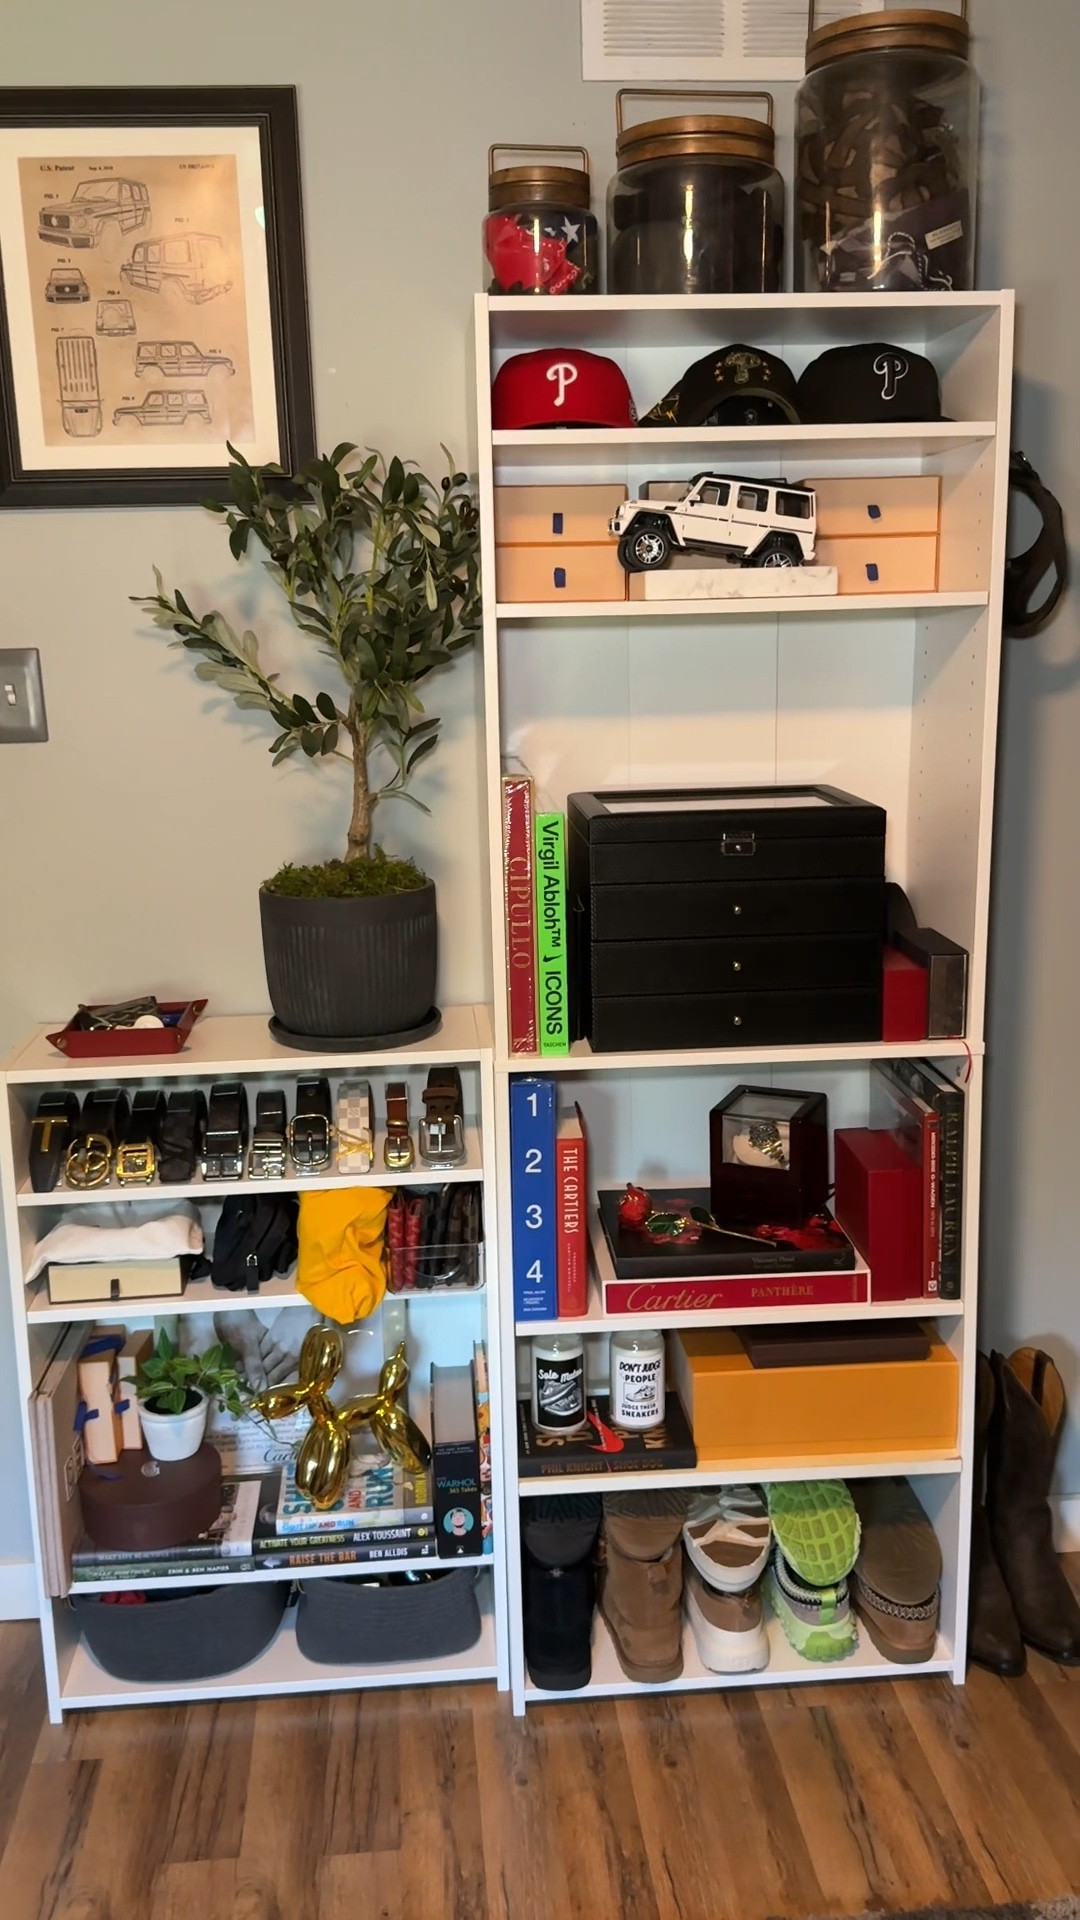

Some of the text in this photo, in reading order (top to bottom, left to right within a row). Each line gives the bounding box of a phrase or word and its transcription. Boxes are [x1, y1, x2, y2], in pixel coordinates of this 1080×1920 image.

[546, 362, 578, 407] P
[873, 352, 909, 400] P
[538, 820, 560, 870] Virgil
[510, 856, 532, 969] CIPULLO
[545, 970, 563, 1035] ICONS
[526, 1092, 537, 1117] 1
[525, 1148, 542, 1173] 2
[562, 1148, 579, 1234] THE CARTIERS
[944, 1112, 958, 1256] RALPH LAUREN
[526, 1204, 543, 1229] 3
[526, 1260, 543, 1283] 4
[626, 1284, 814, 1312] Cartier PANTHÈRE
[538, 1368, 559, 1380] Sole
[619, 1358, 662, 1373] DON'T JUDGE
[624, 1374, 656, 1383] PEOPLE
[621, 1408, 659, 1418] SNEAKERS
[541, 1458, 664, 1474] PHIL KNIGHT SHOE DOG
[365, 1467, 394, 1508] RUN
[436, 1478, 478, 1488] WARHOL
[347, 1488, 362, 1510] AND
[318, 1520, 336, 1529] AND
[337, 1518, 355, 1527] RUN
[259, 1528, 411, 1548] ACTIVATE YOUR GREATNESS ALEX TOUSSAINT
[289, 1554, 316, 1566] RAISE
[319, 1552, 335, 1564] THE
[338, 1550, 357, 1562] BAR
[369, 1550, 383, 1559] BEN
